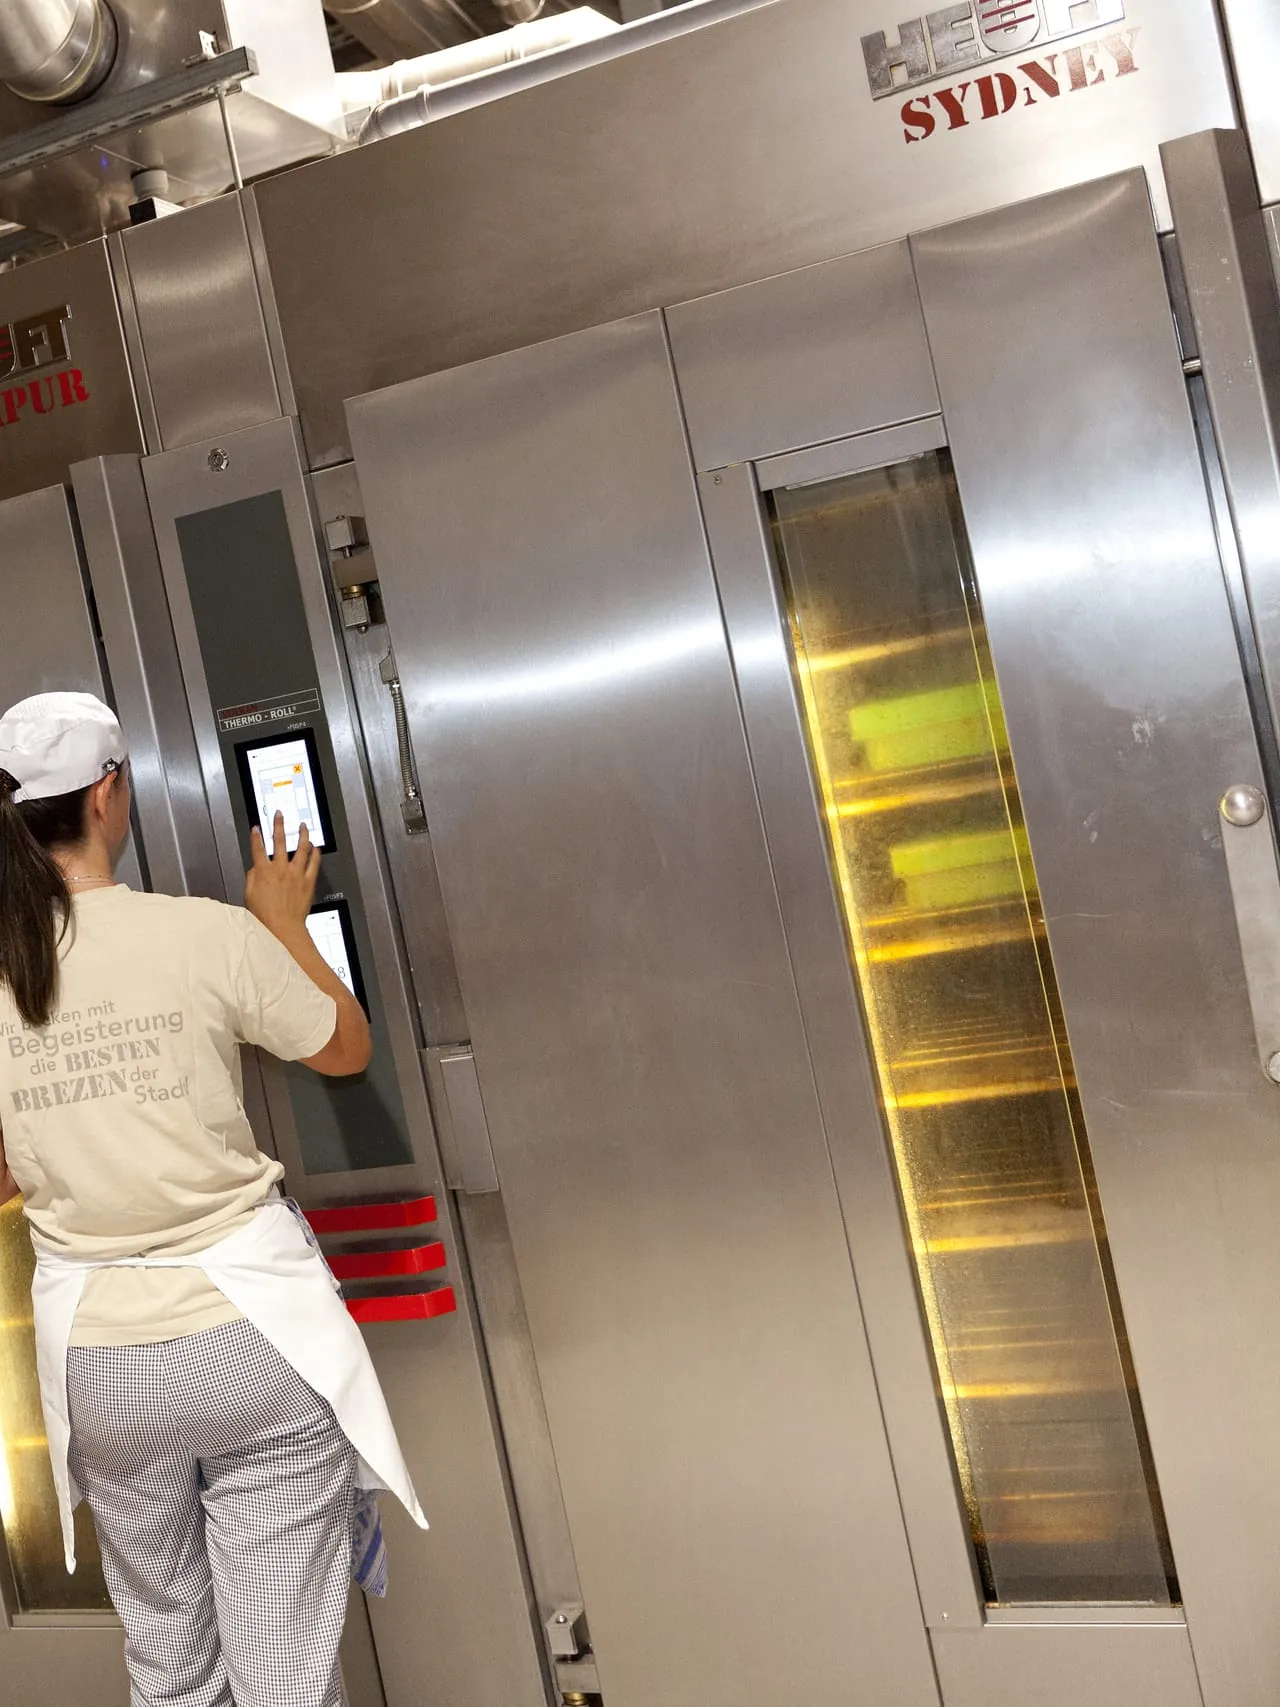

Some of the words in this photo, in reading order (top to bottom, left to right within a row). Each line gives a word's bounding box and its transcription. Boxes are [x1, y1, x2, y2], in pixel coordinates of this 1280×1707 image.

[900, 26, 1141, 143] SYDNEY
[223, 713, 263, 729] THERMO
[87, 1000, 116, 1017] mit
[8, 1010, 184, 1058] Begeisterung
[30, 1058, 57, 1076] die
[64, 1037, 161, 1073] BESTEN
[10, 1069, 128, 1113] BREZEN
[130, 1065, 159, 1082] der
